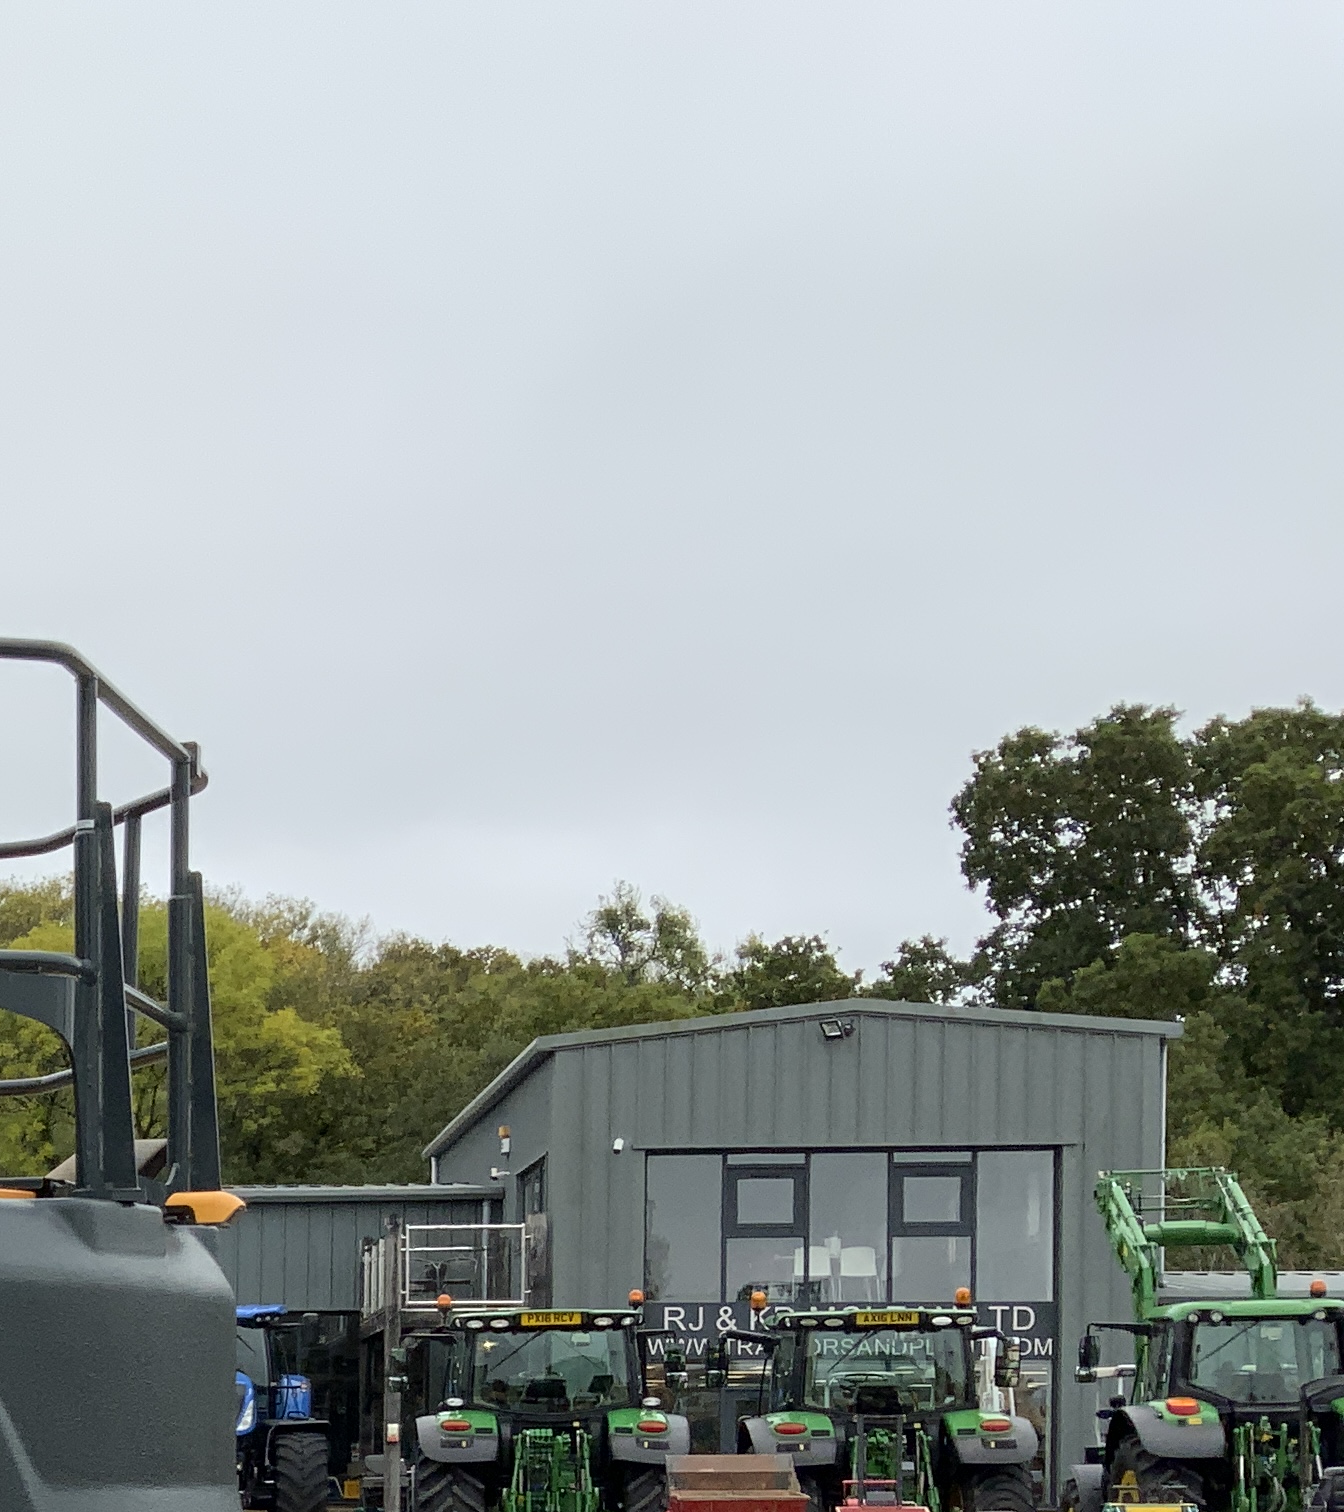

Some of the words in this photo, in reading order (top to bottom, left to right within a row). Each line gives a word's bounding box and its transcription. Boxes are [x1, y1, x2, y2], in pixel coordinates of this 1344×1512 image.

[664, 1306, 704, 1331] RJ
[716, 1306, 737, 1331] &
[988, 1306, 1035, 1331] TD
